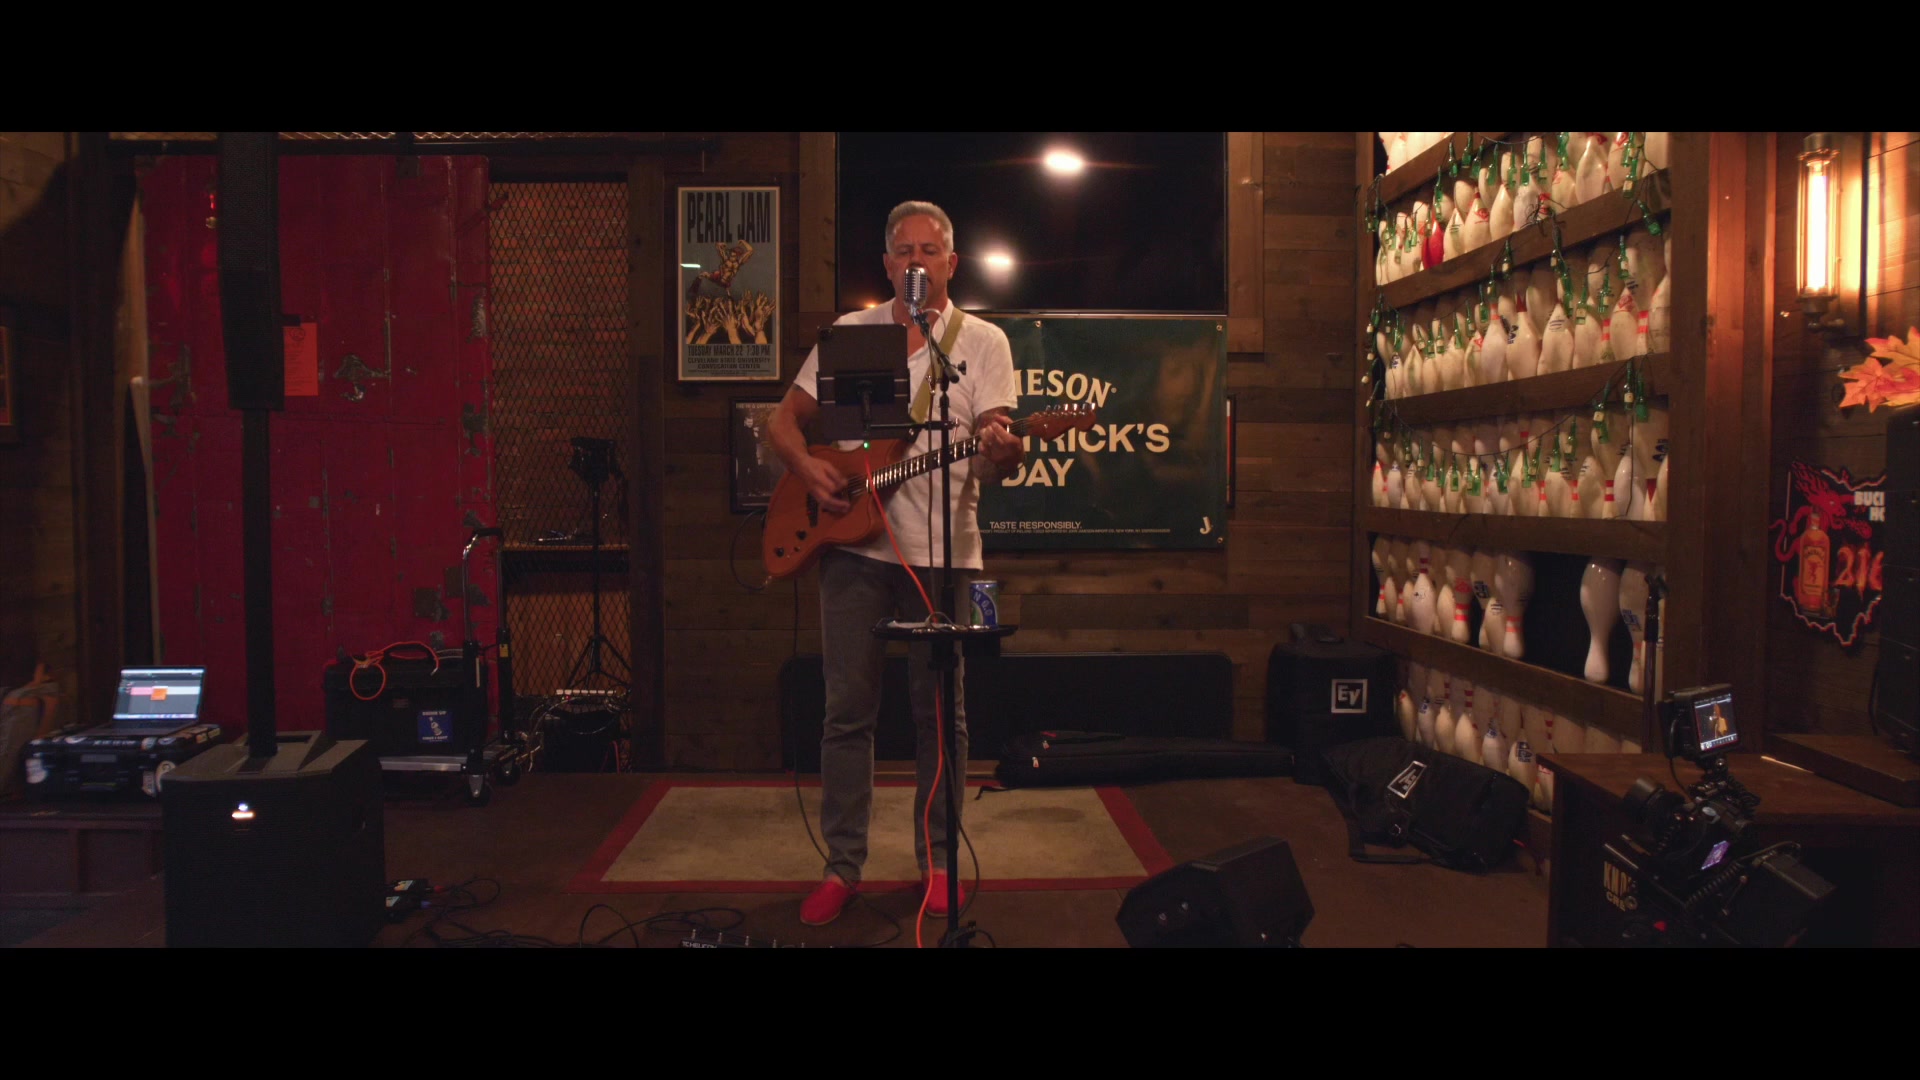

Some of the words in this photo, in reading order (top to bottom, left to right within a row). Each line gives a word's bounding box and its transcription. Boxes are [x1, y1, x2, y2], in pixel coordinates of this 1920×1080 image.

[688, 192, 733, 243] PEARL
[738, 192, 771, 243] JAM
[688, 345, 712, 356] TUESDAY
[713, 345, 734, 356] MARCH
[760, 345, 770, 356] PM
[989, 521, 1017, 529] TASTE
[1019, 521, 1082, 530] RESPONSIBLY.
